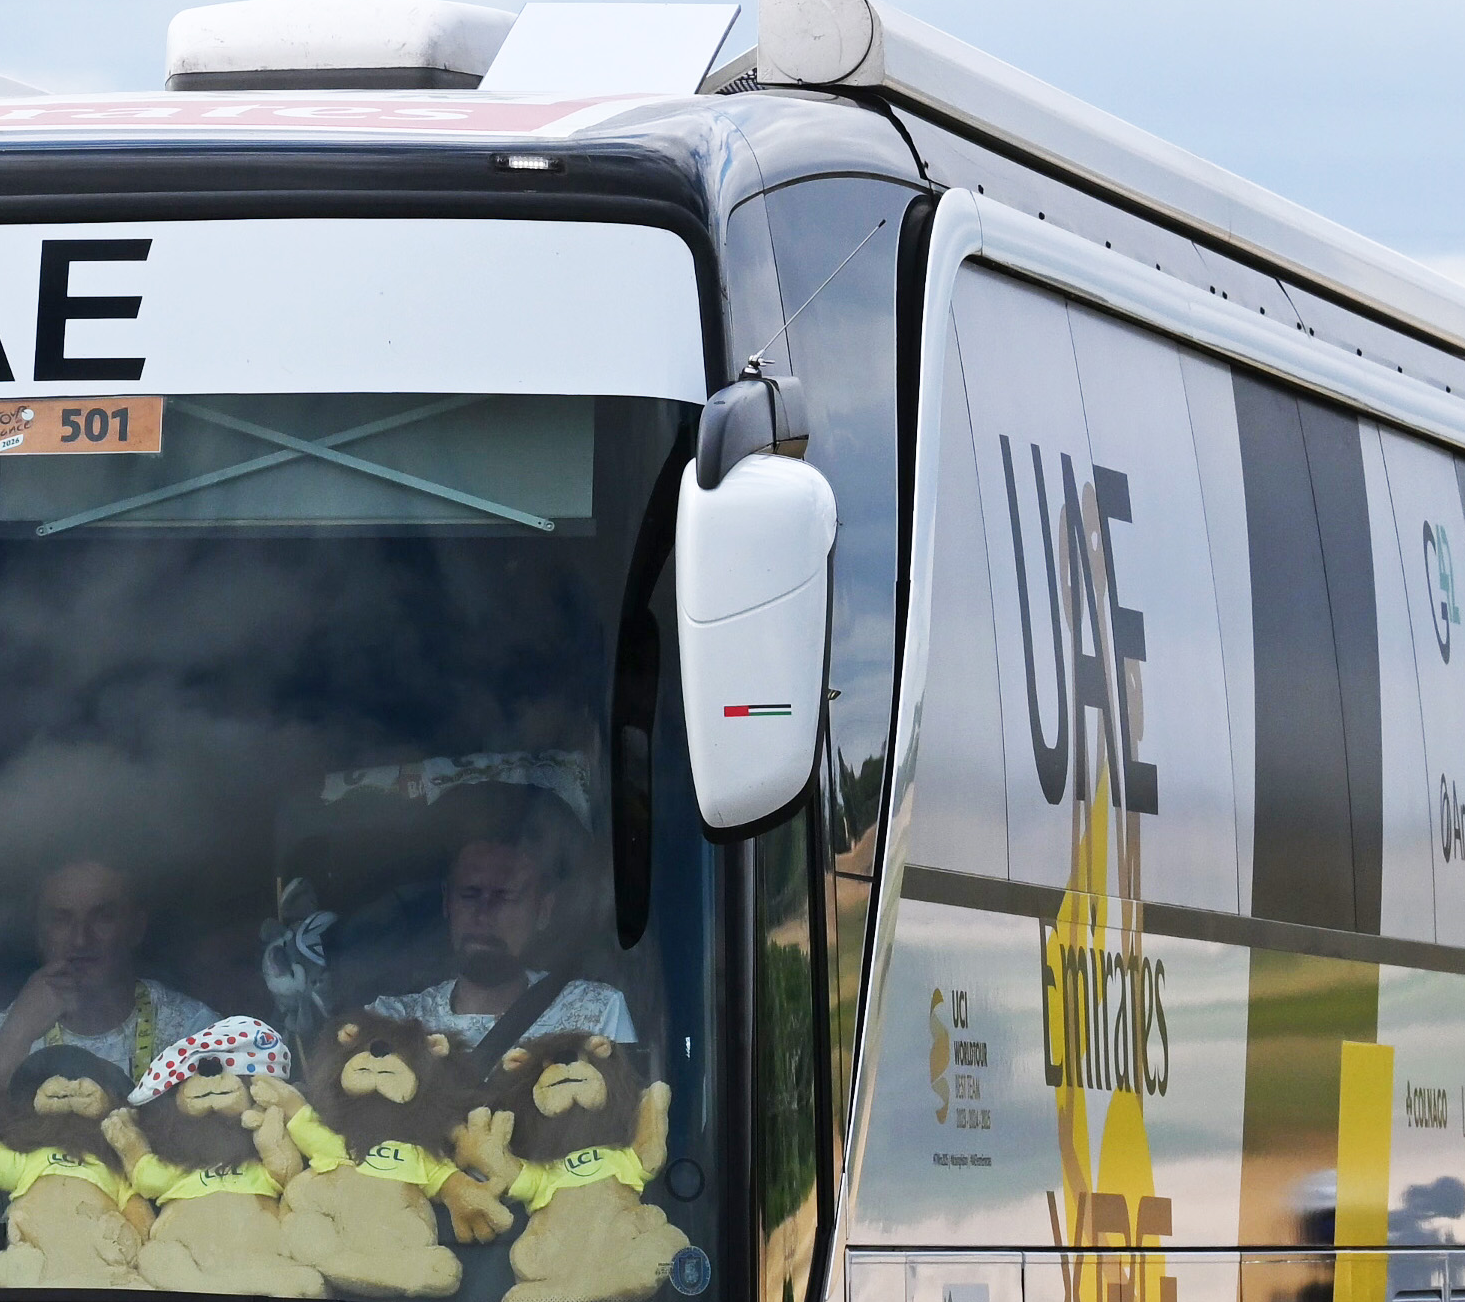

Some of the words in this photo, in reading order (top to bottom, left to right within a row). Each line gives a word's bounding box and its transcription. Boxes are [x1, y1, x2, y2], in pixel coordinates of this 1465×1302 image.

[2, 437, 20, 448] 2026
[60, 407, 130, 443] 501
[998, 434, 1159, 815] UAE
[951, 990, 969, 1029] UCI
[1039, 907, 1169, 1098] Emirates
[954, 1041, 988, 1068] WORLDTOUR
[1413, 1087, 1448, 1129] COLNAGO
[366, 1146, 405, 1163] LCL
[567, 1149, 605, 1170] LCL
